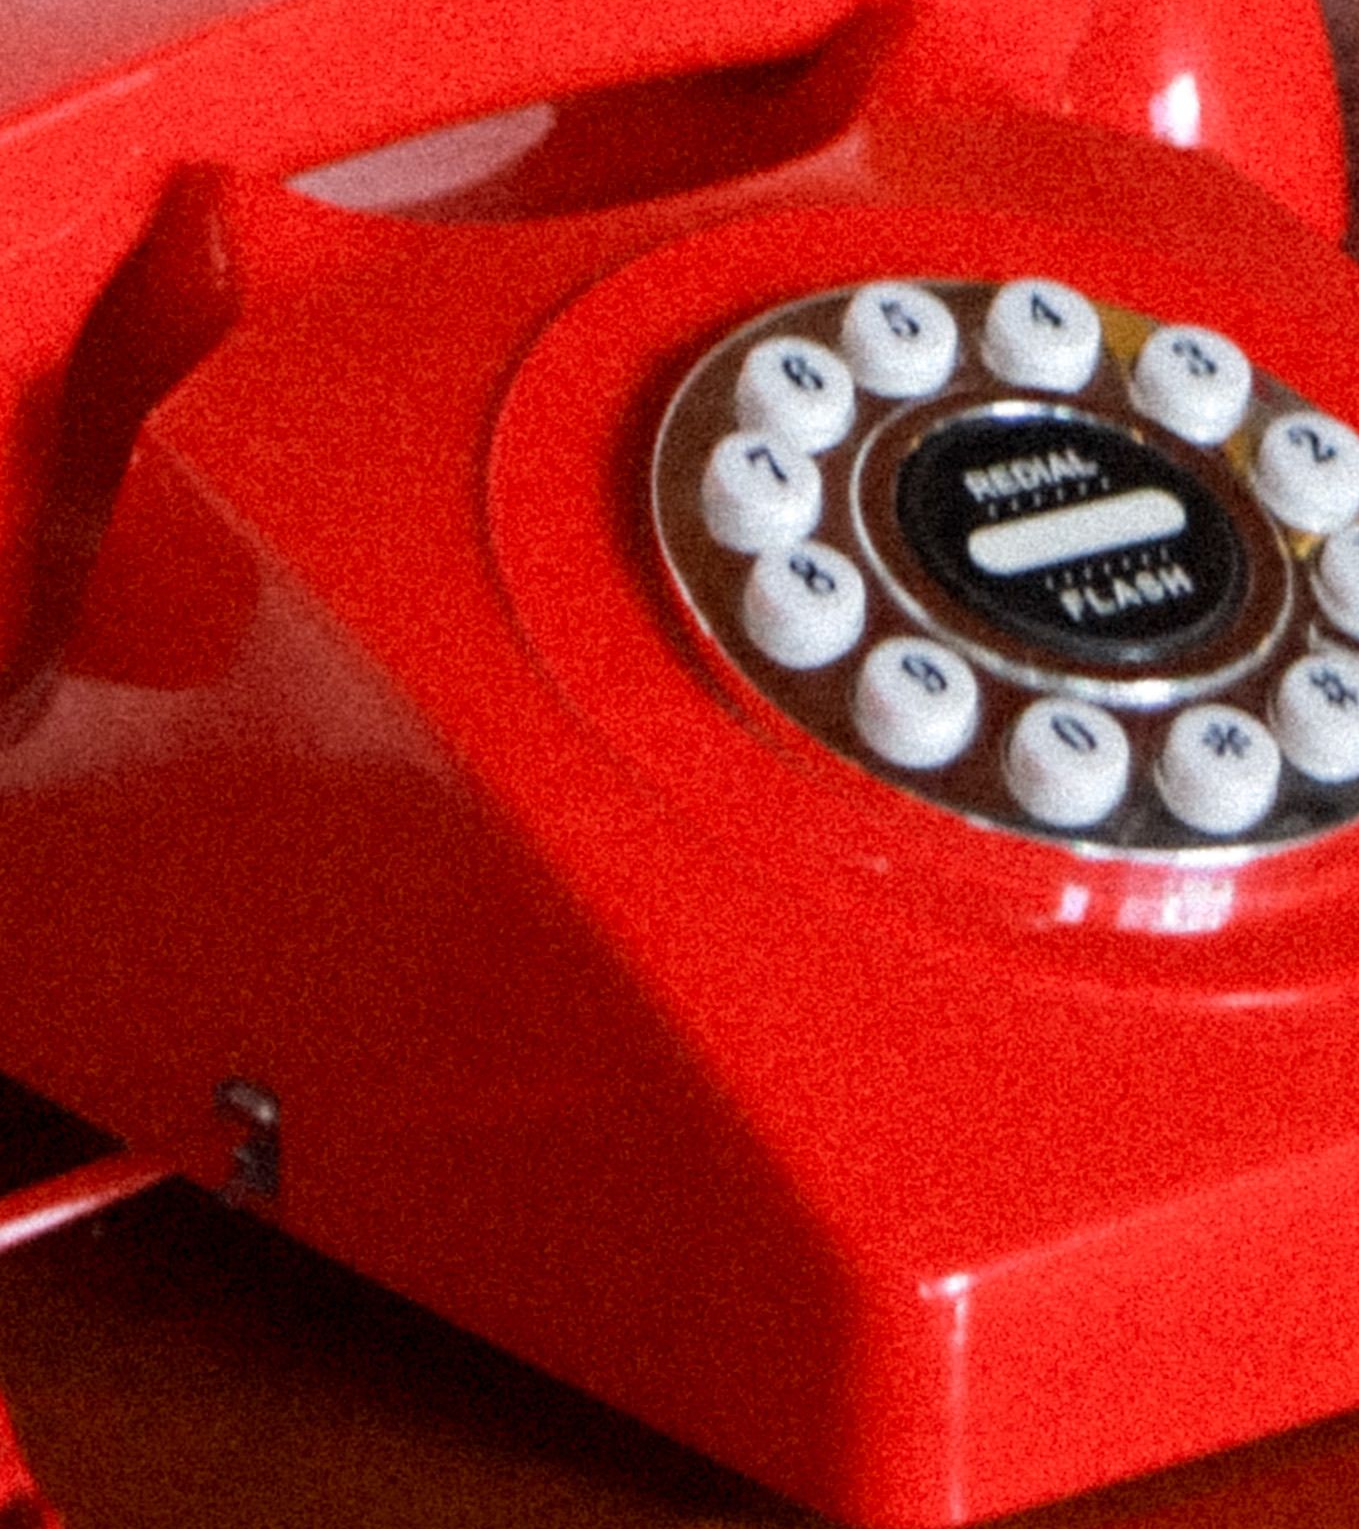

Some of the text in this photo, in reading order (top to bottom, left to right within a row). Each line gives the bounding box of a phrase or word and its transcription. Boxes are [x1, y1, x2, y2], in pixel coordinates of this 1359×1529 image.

[879, 298, 922, 339] 5
[1027, 288, 1067, 331] 4
[779, 352, 827, 392] 6
[1170, 335, 1219, 377] 3
[743, 443, 790, 487] 7
[1284, 425, 1340, 466] 2
[961, 445, 1099, 504] REDIAL
[786, 553, 838, 598] 8
[1060, 562, 1196, 625] FLASH
[900, 651, 950, 697] 9
[1049, 713, 1100, 754] 0
